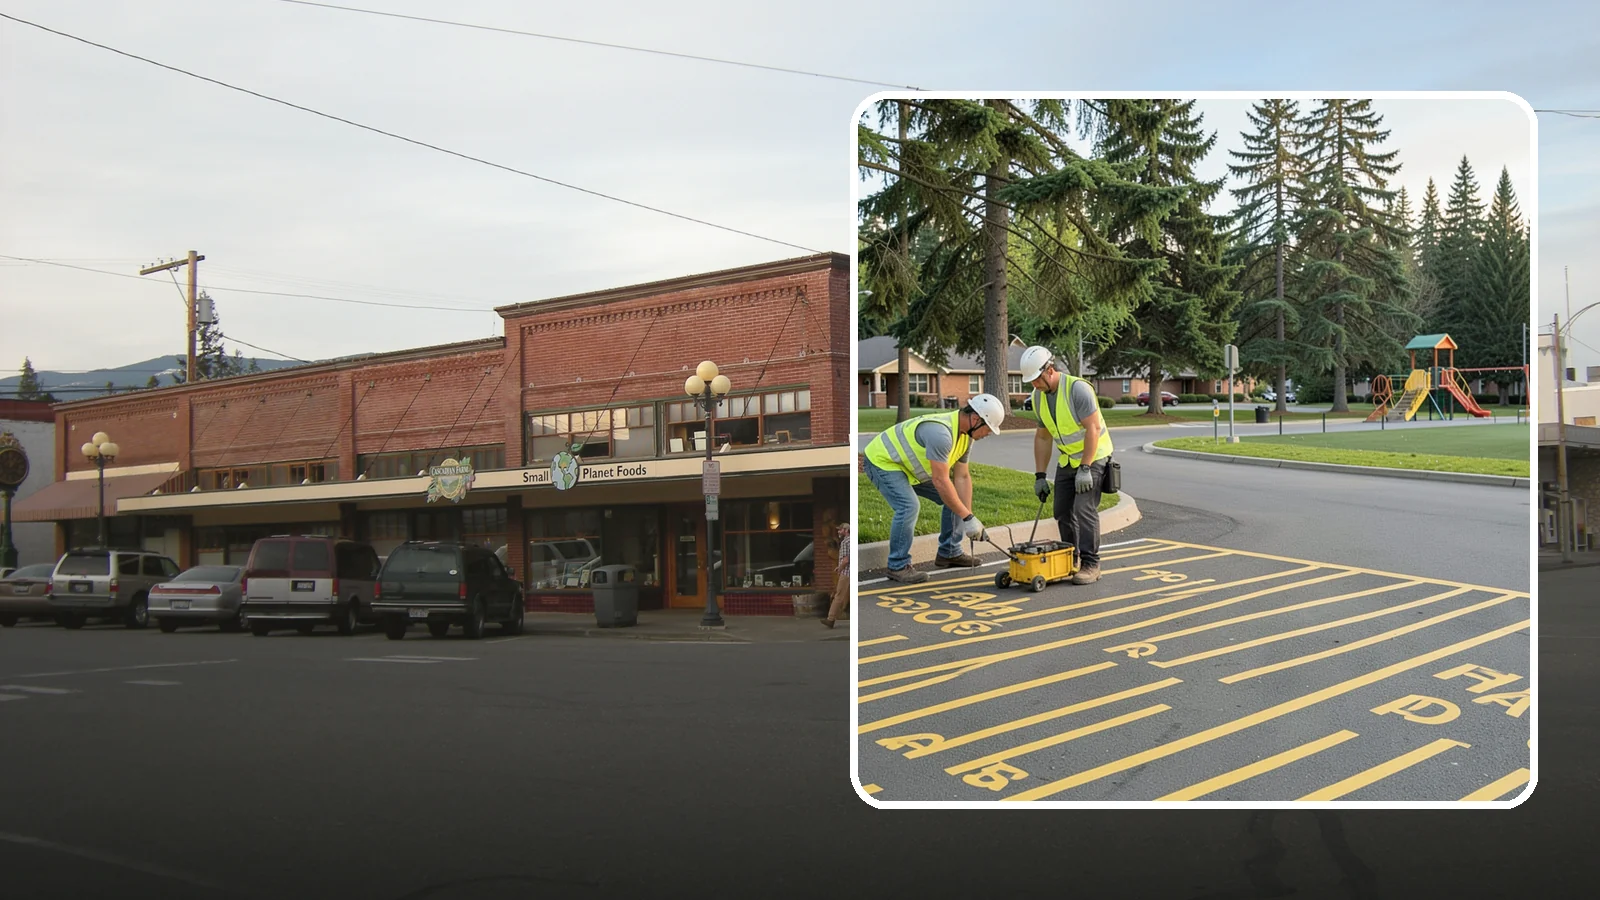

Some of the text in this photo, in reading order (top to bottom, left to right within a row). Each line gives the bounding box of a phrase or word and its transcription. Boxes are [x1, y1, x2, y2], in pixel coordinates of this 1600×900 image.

[522, 464, 647, 483] Small Planet Foods
